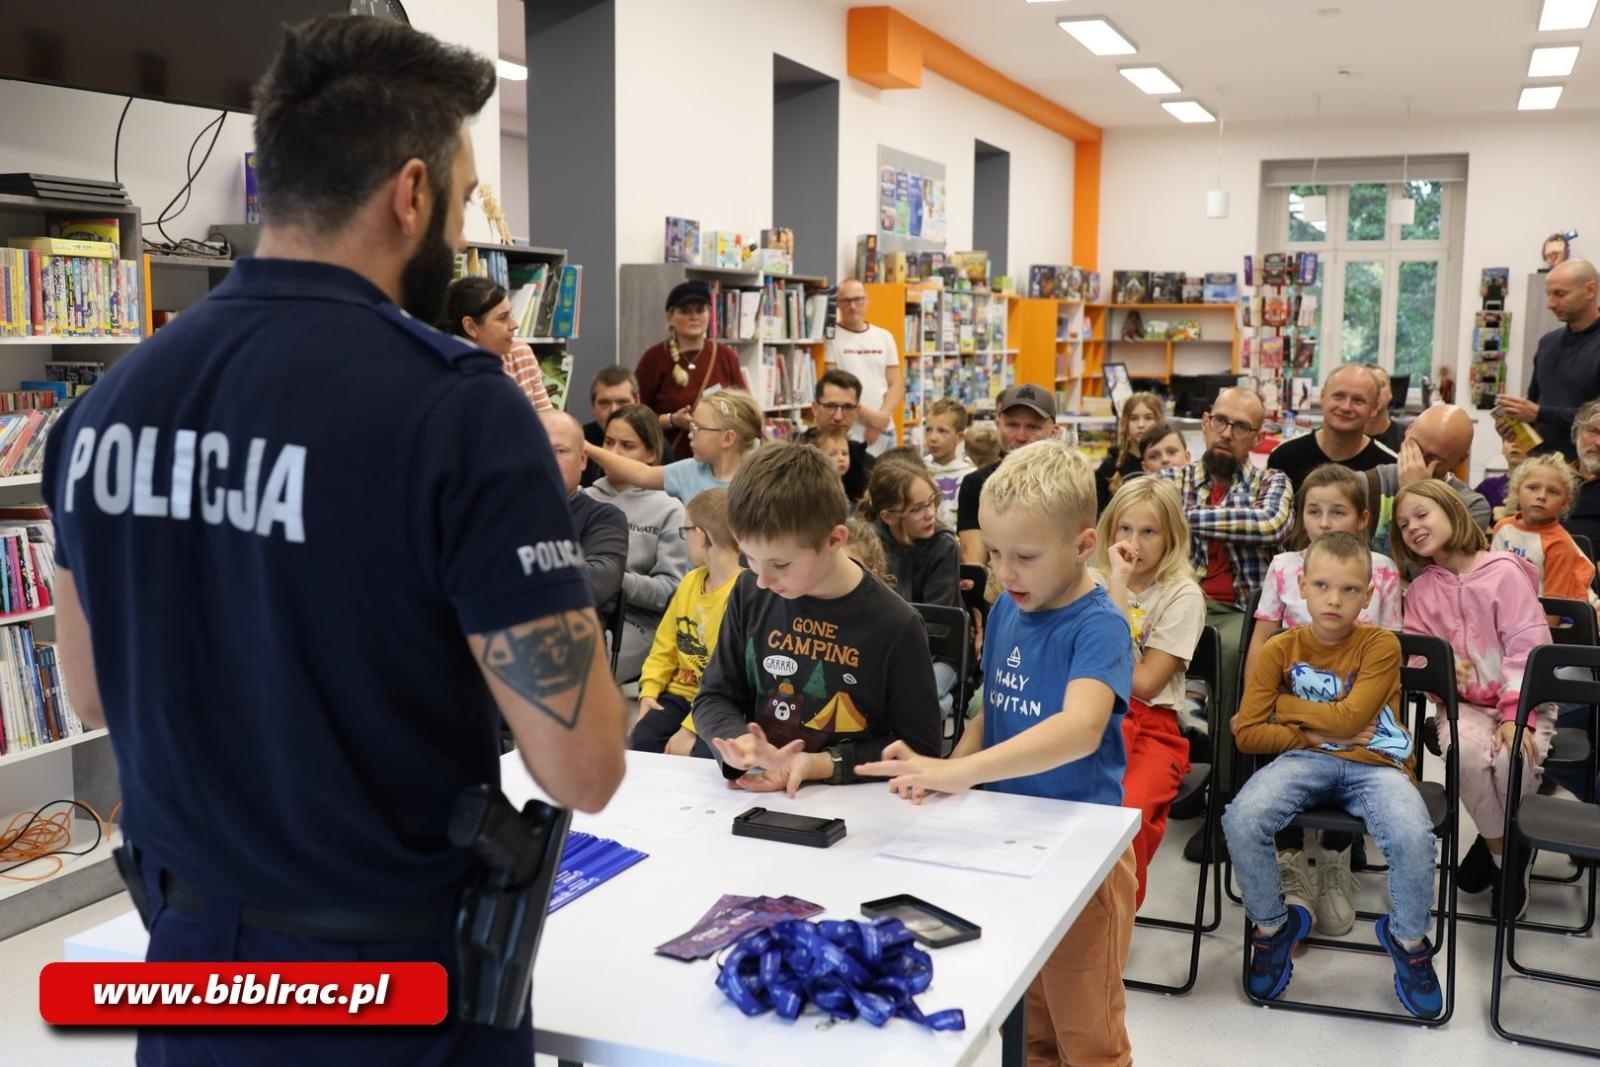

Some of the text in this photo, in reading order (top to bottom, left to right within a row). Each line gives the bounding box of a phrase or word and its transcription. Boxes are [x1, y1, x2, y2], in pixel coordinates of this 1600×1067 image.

[64, 422, 307, 543] POLICJA
[792, 617, 838, 639] GONE
[767, 629, 860, 668] CAMPING
[989, 689, 1041, 717] KPITAN
